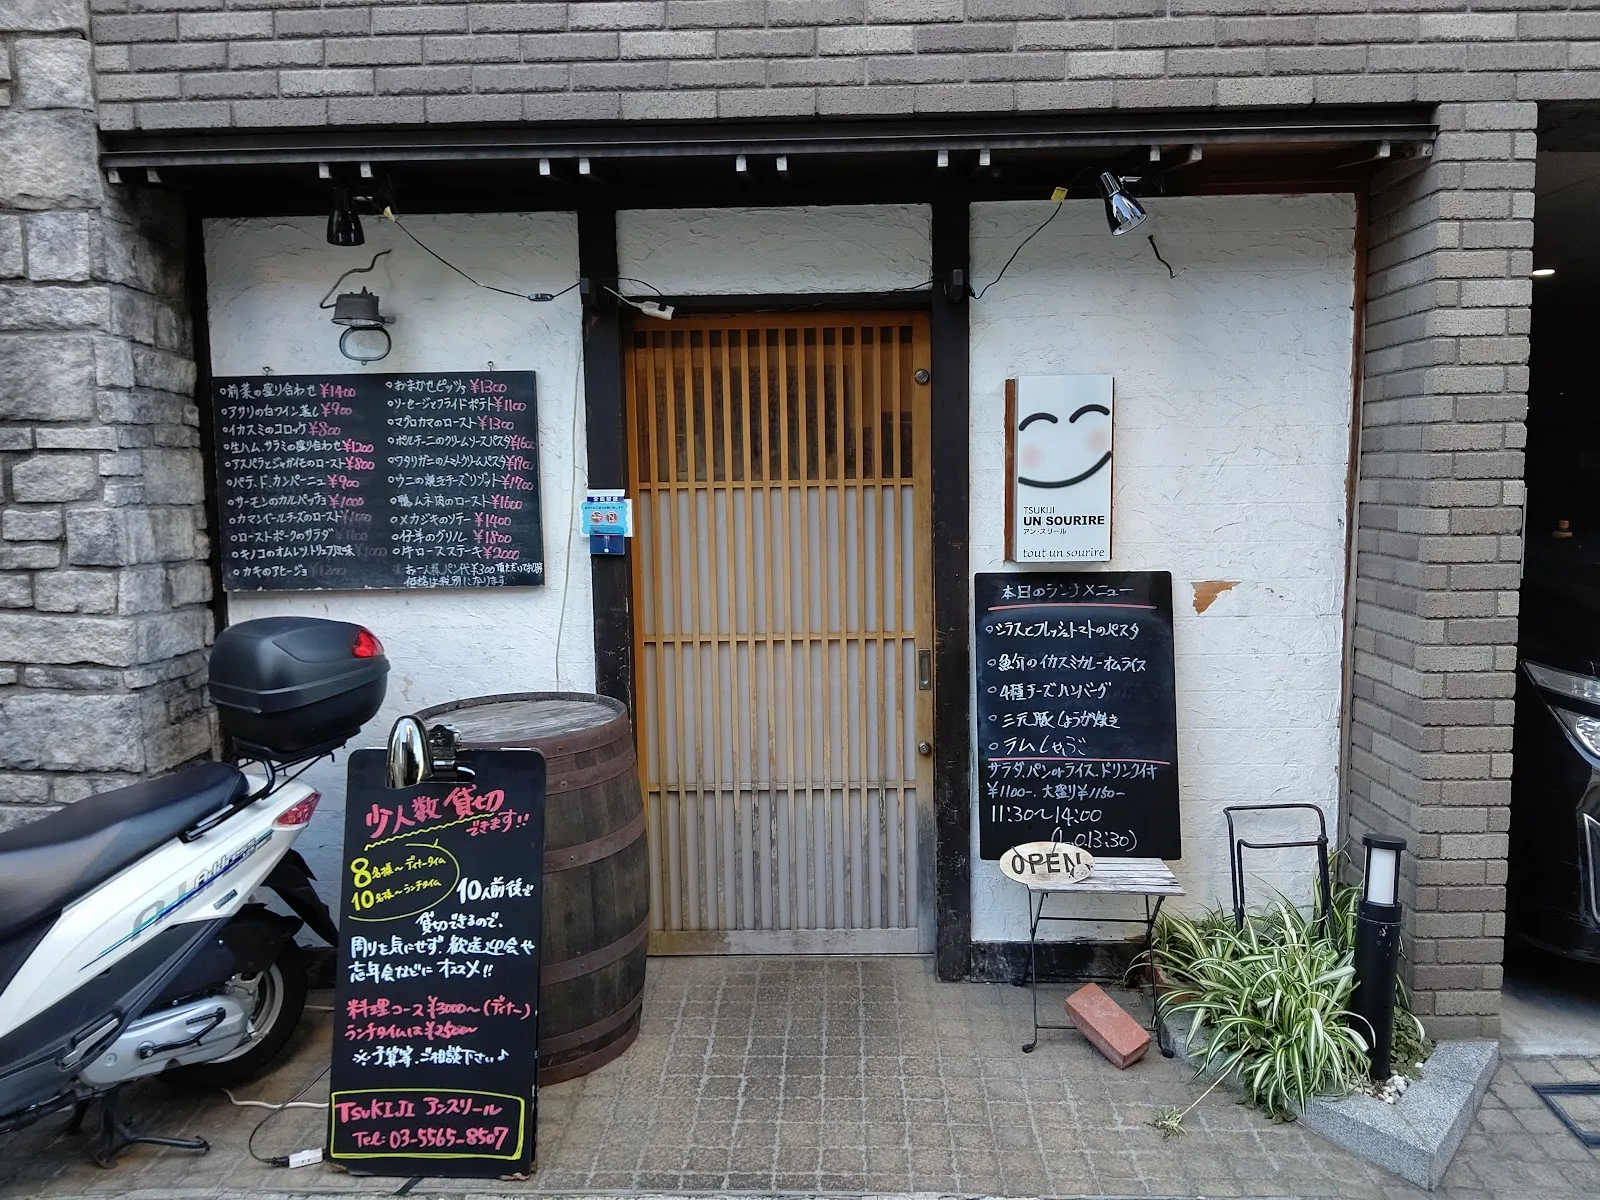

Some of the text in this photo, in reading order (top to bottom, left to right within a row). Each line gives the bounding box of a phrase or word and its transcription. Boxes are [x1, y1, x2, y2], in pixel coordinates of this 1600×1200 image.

[320, 383, 356, 398] ¥1400
[470, 378, 507, 394] ¥1300
[321, 402, 352, 417] ¥900
[494, 395, 526, 412] ¥1100
[228, 421, 341, 437] イカスミのコロッケ ¥800
[477, 415, 514, 430] ¥1300
[342, 439, 374, 453] ¥1200
[345, 456, 375, 470] ¥800
[327, 474, 360, 489] ¥900
[501, 473, 534, 491] ¥1700
[328, 494, 364, 509] ¥1000
[491, 494, 522, 509] ¥1600
[1023, 506, 1055, 515] TSUKIJI
[474, 512, 511, 527] ¥1400
[1023, 515, 1105, 526] UN SOURIRE
[400, 527, 512, 544] 仔羊のグリル ¥1800
[483, 546, 520, 560] ¥2000
[1023, 547, 1105, 558] tout un sourire
[1001, 583, 1135, 600] 本日のランチメニュー
[1011, 852, 1083, 876] OPEN
[423, 1096, 503, 1116] アンスリール
[389, 1126, 510, 1150] 03-5565-8507
